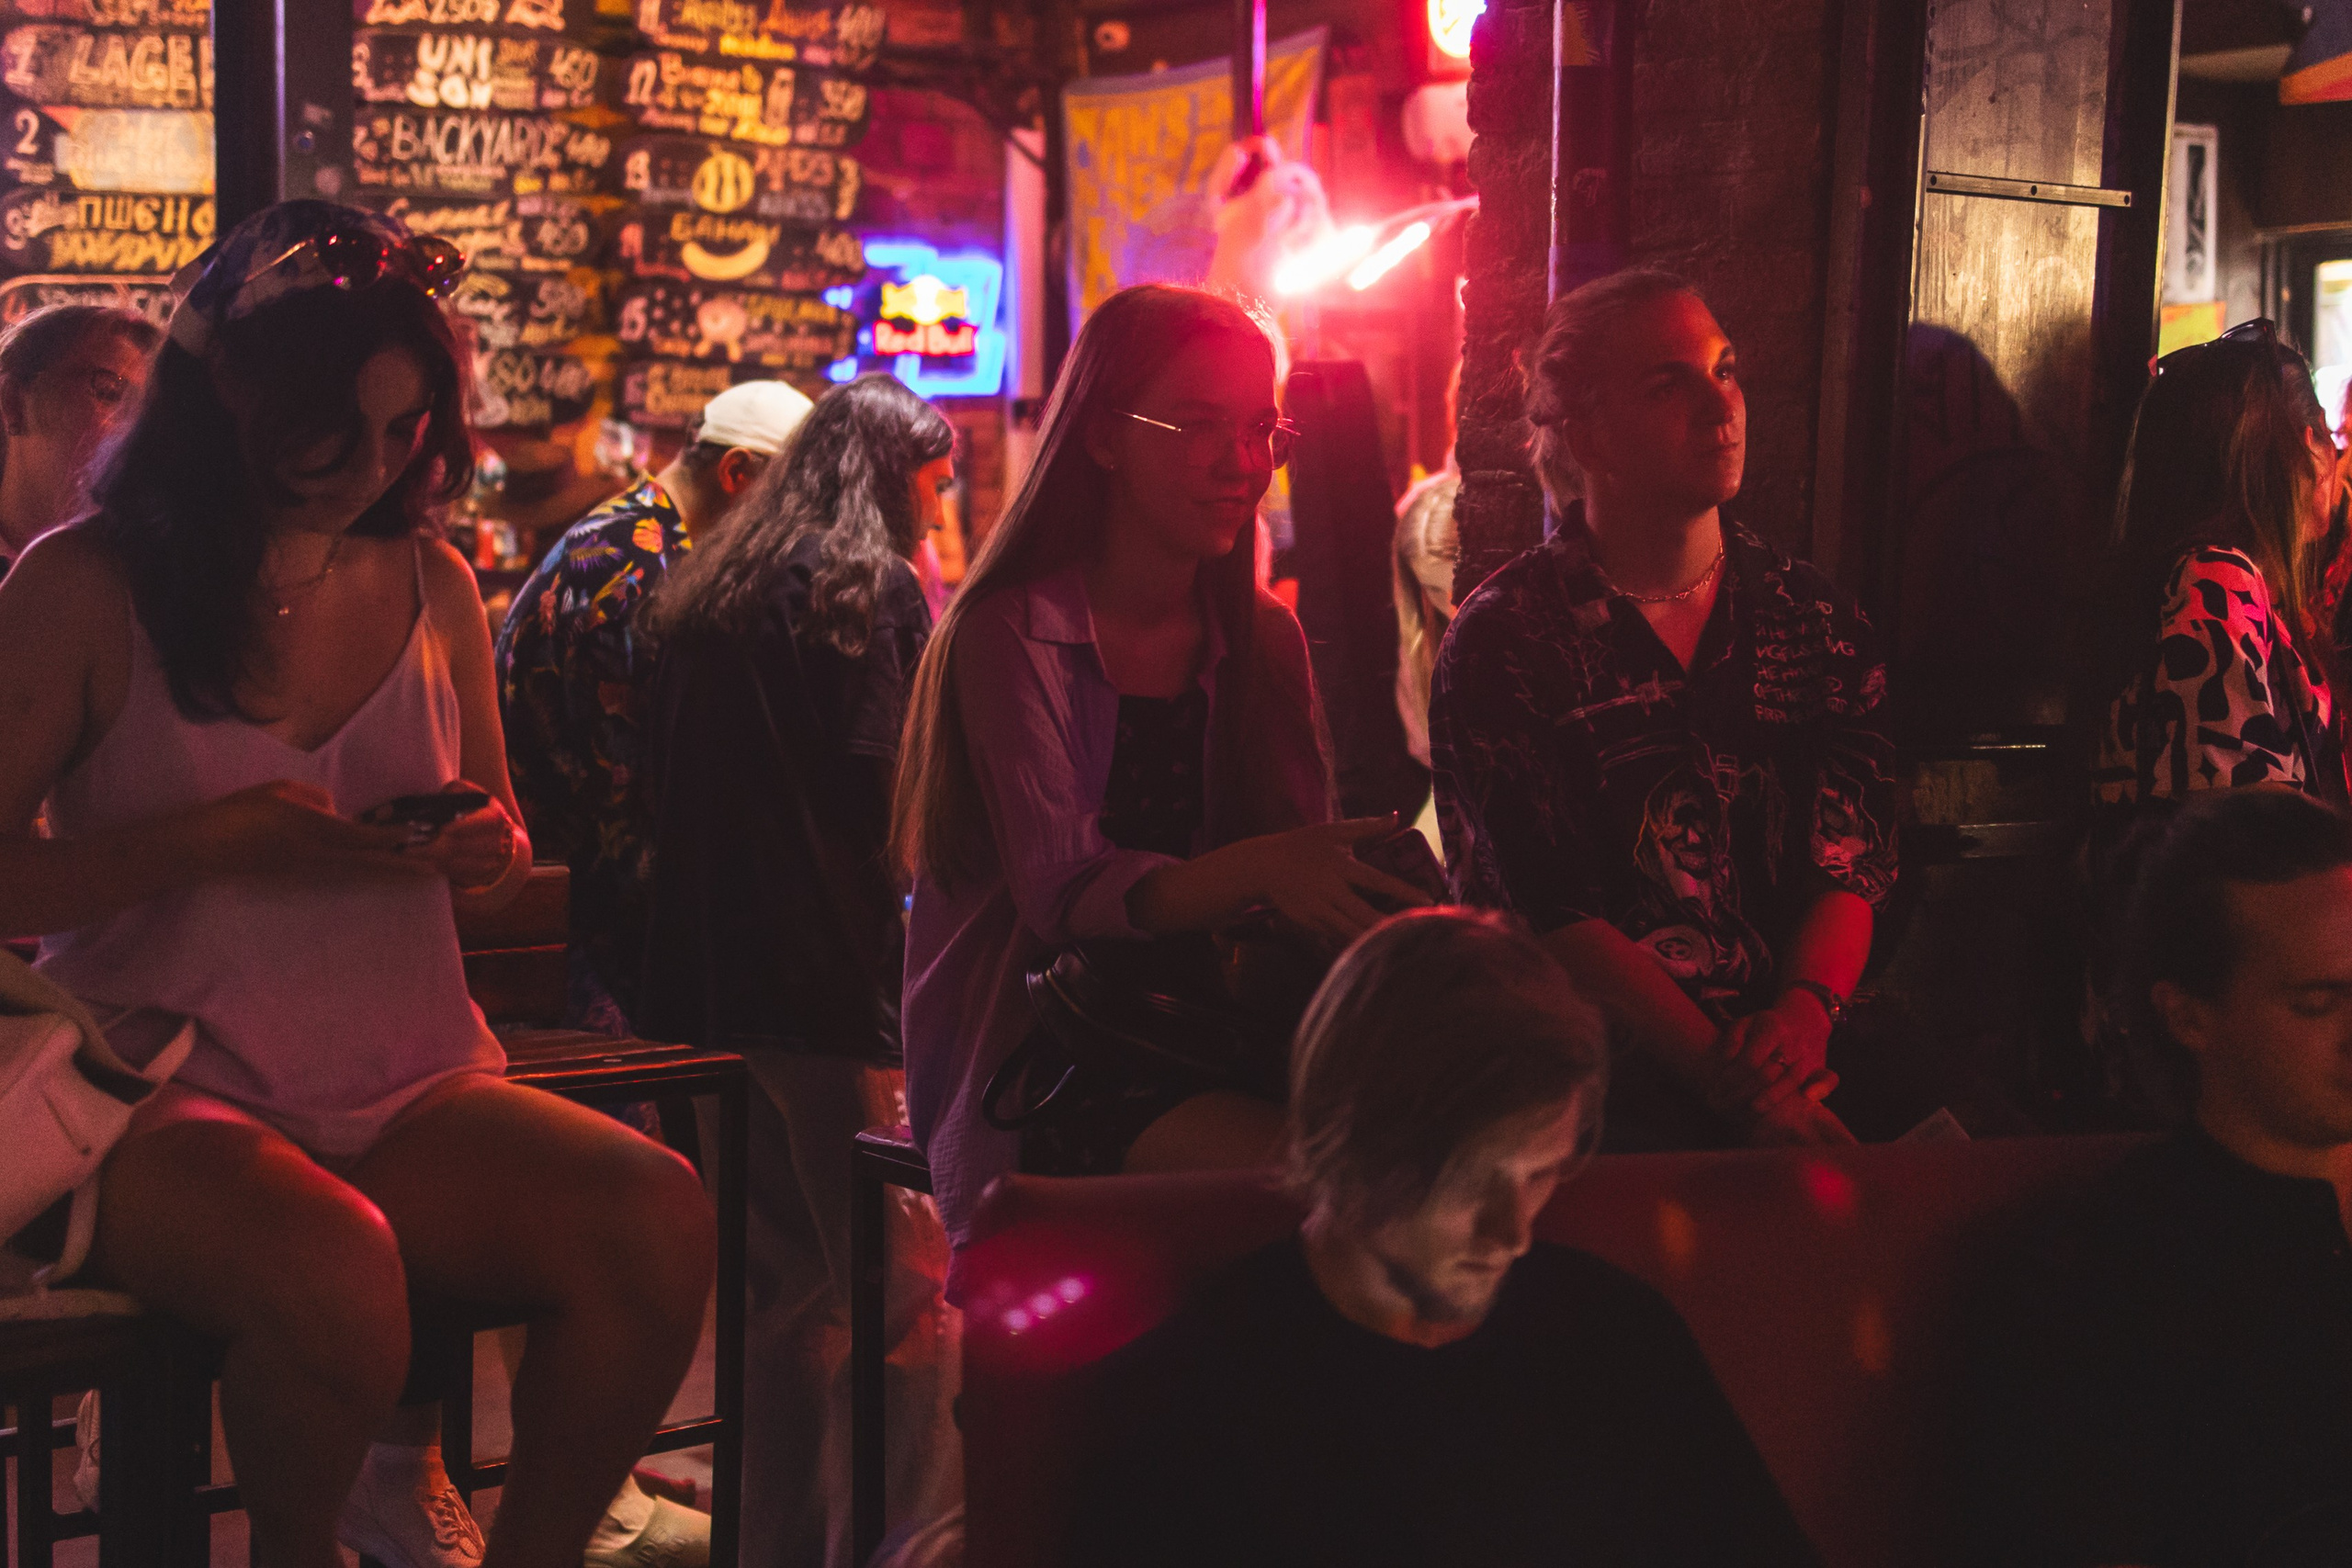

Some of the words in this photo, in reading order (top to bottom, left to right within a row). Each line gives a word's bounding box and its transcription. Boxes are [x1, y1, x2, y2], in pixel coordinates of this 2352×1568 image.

[15, 108, 40, 155] 2
[874, 320, 924, 355] Red
[926, 321, 978, 356] Bull
